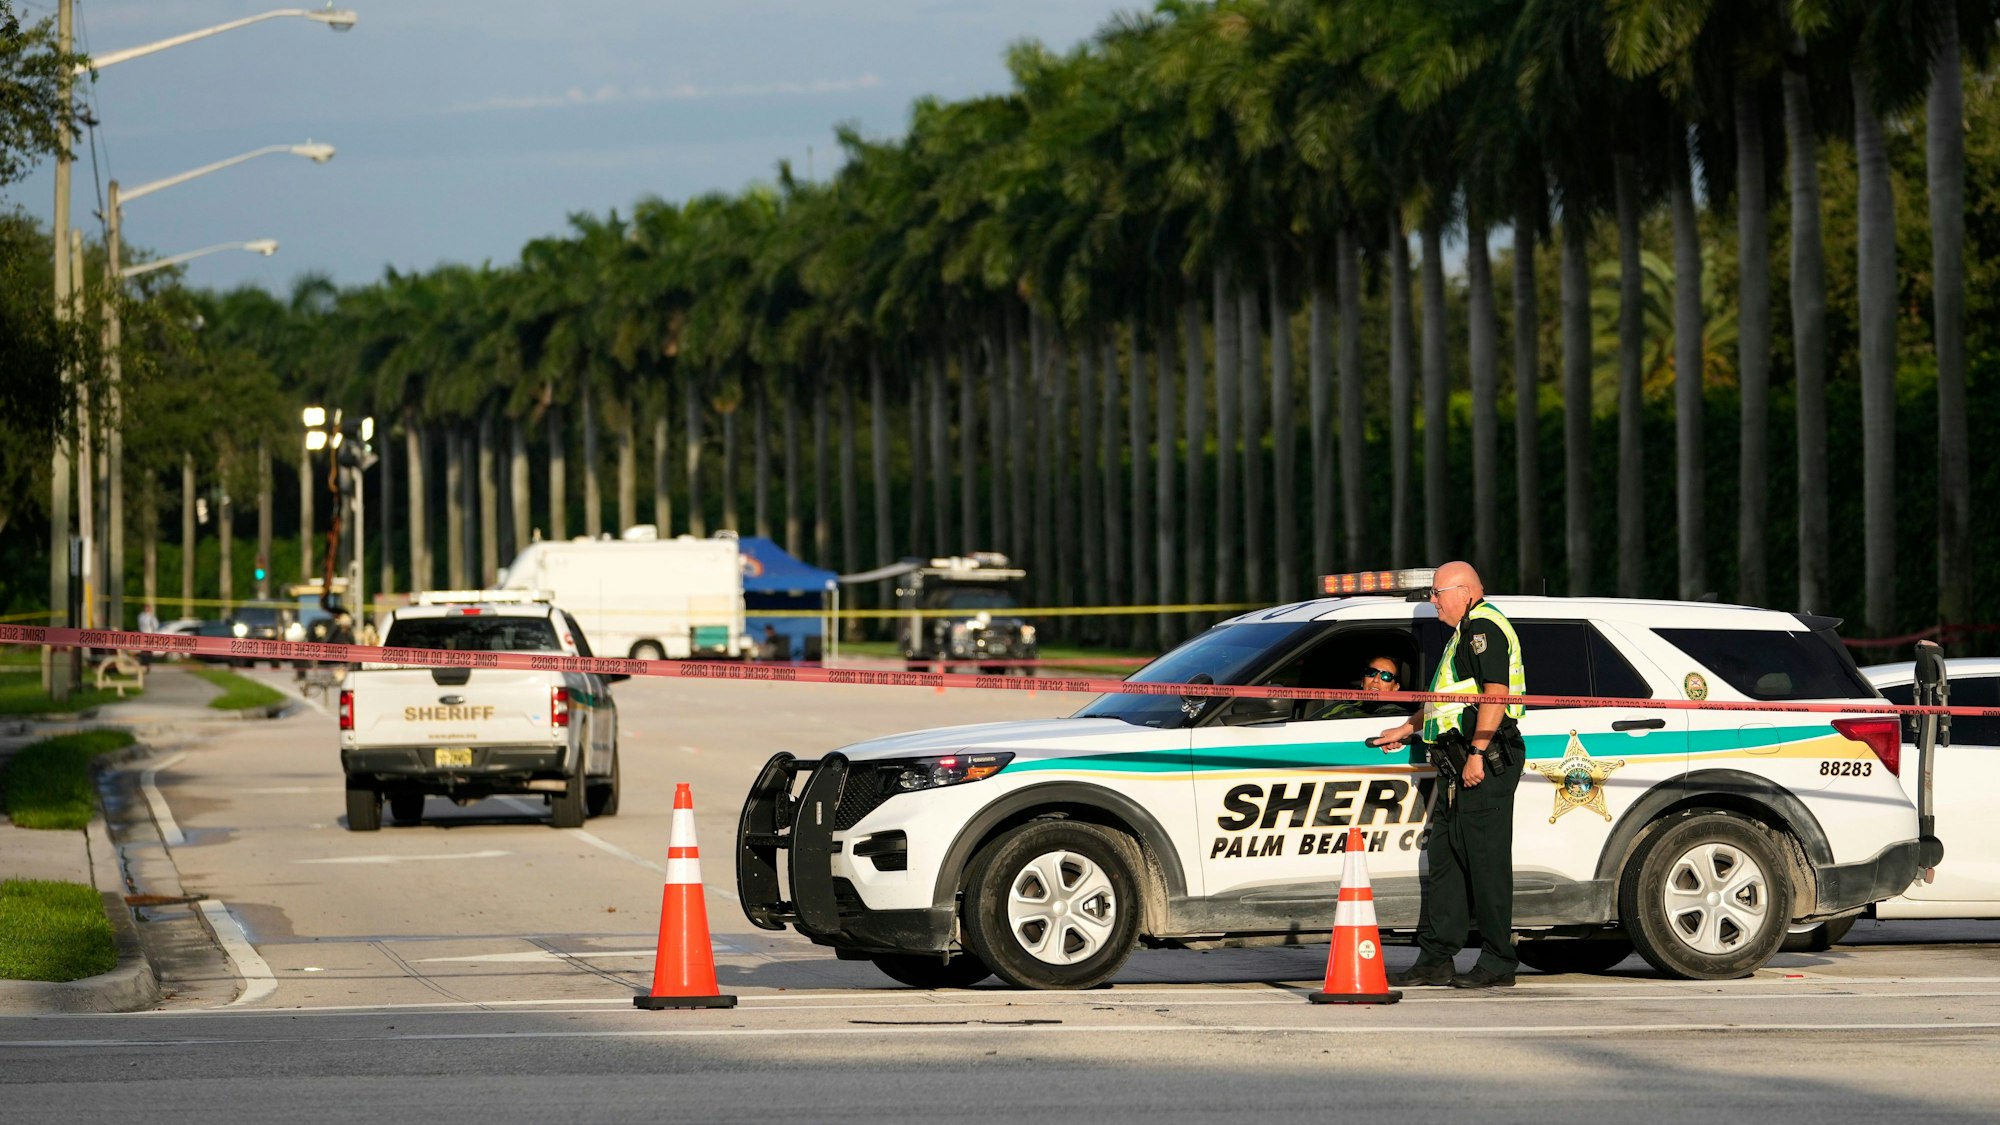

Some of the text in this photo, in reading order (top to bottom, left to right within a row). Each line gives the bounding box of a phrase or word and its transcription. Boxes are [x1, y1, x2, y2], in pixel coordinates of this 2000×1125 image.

[404, 706, 494, 721] SHERIFF
[1819, 761, 1873, 777] 88283
[1217, 778, 1437, 831] SHERI
[1210, 835, 1284, 859] PALM
